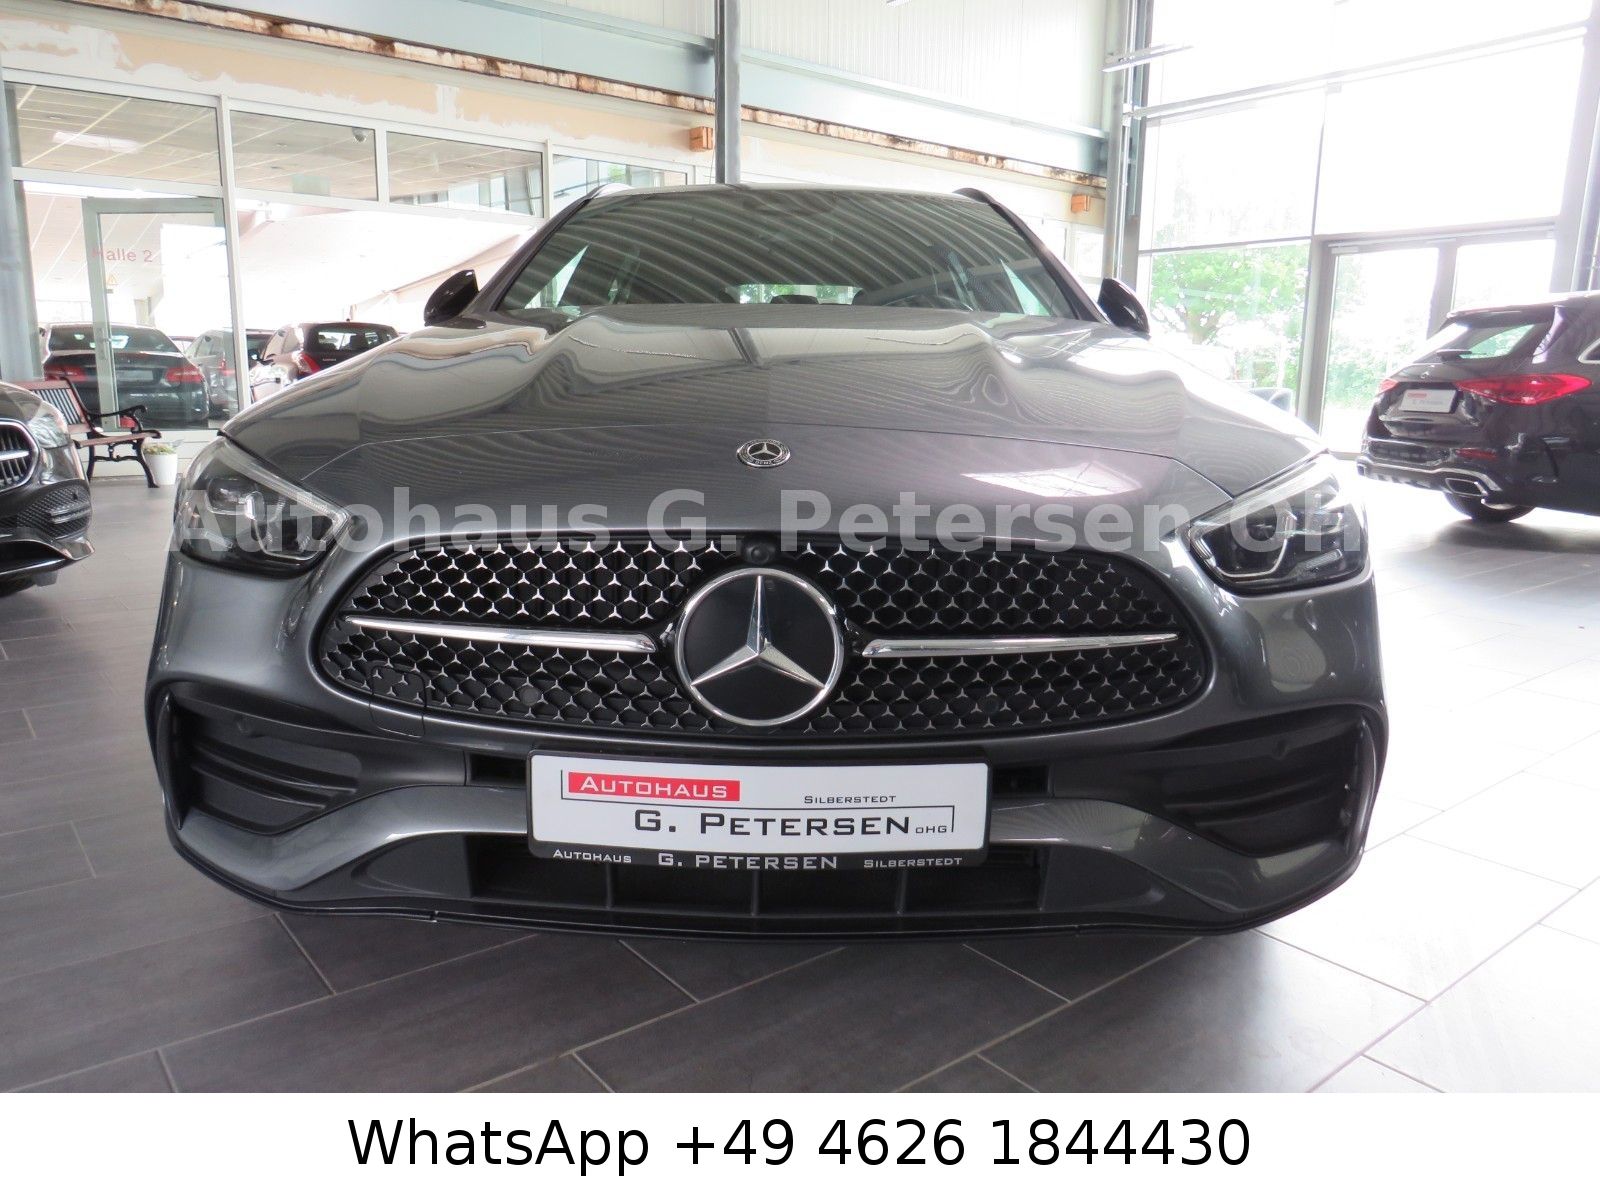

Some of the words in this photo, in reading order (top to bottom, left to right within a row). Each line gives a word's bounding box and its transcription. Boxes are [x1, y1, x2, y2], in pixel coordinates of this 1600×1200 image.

[143, 249, 153, 263] 2
[580, 776, 727, 799] AUTOHAUS
[804, 795, 897, 804] SILBERSTEDT
[634, 809, 677, 833] G.
[700, 812, 910, 836] PETERSEN
[553, 849, 632, 864] AUTOHAUS
[658, 852, 683, 867] G.
[695, 854, 838, 870] PETERSEN
[863, 857, 963, 869] SILBERSTEDT
